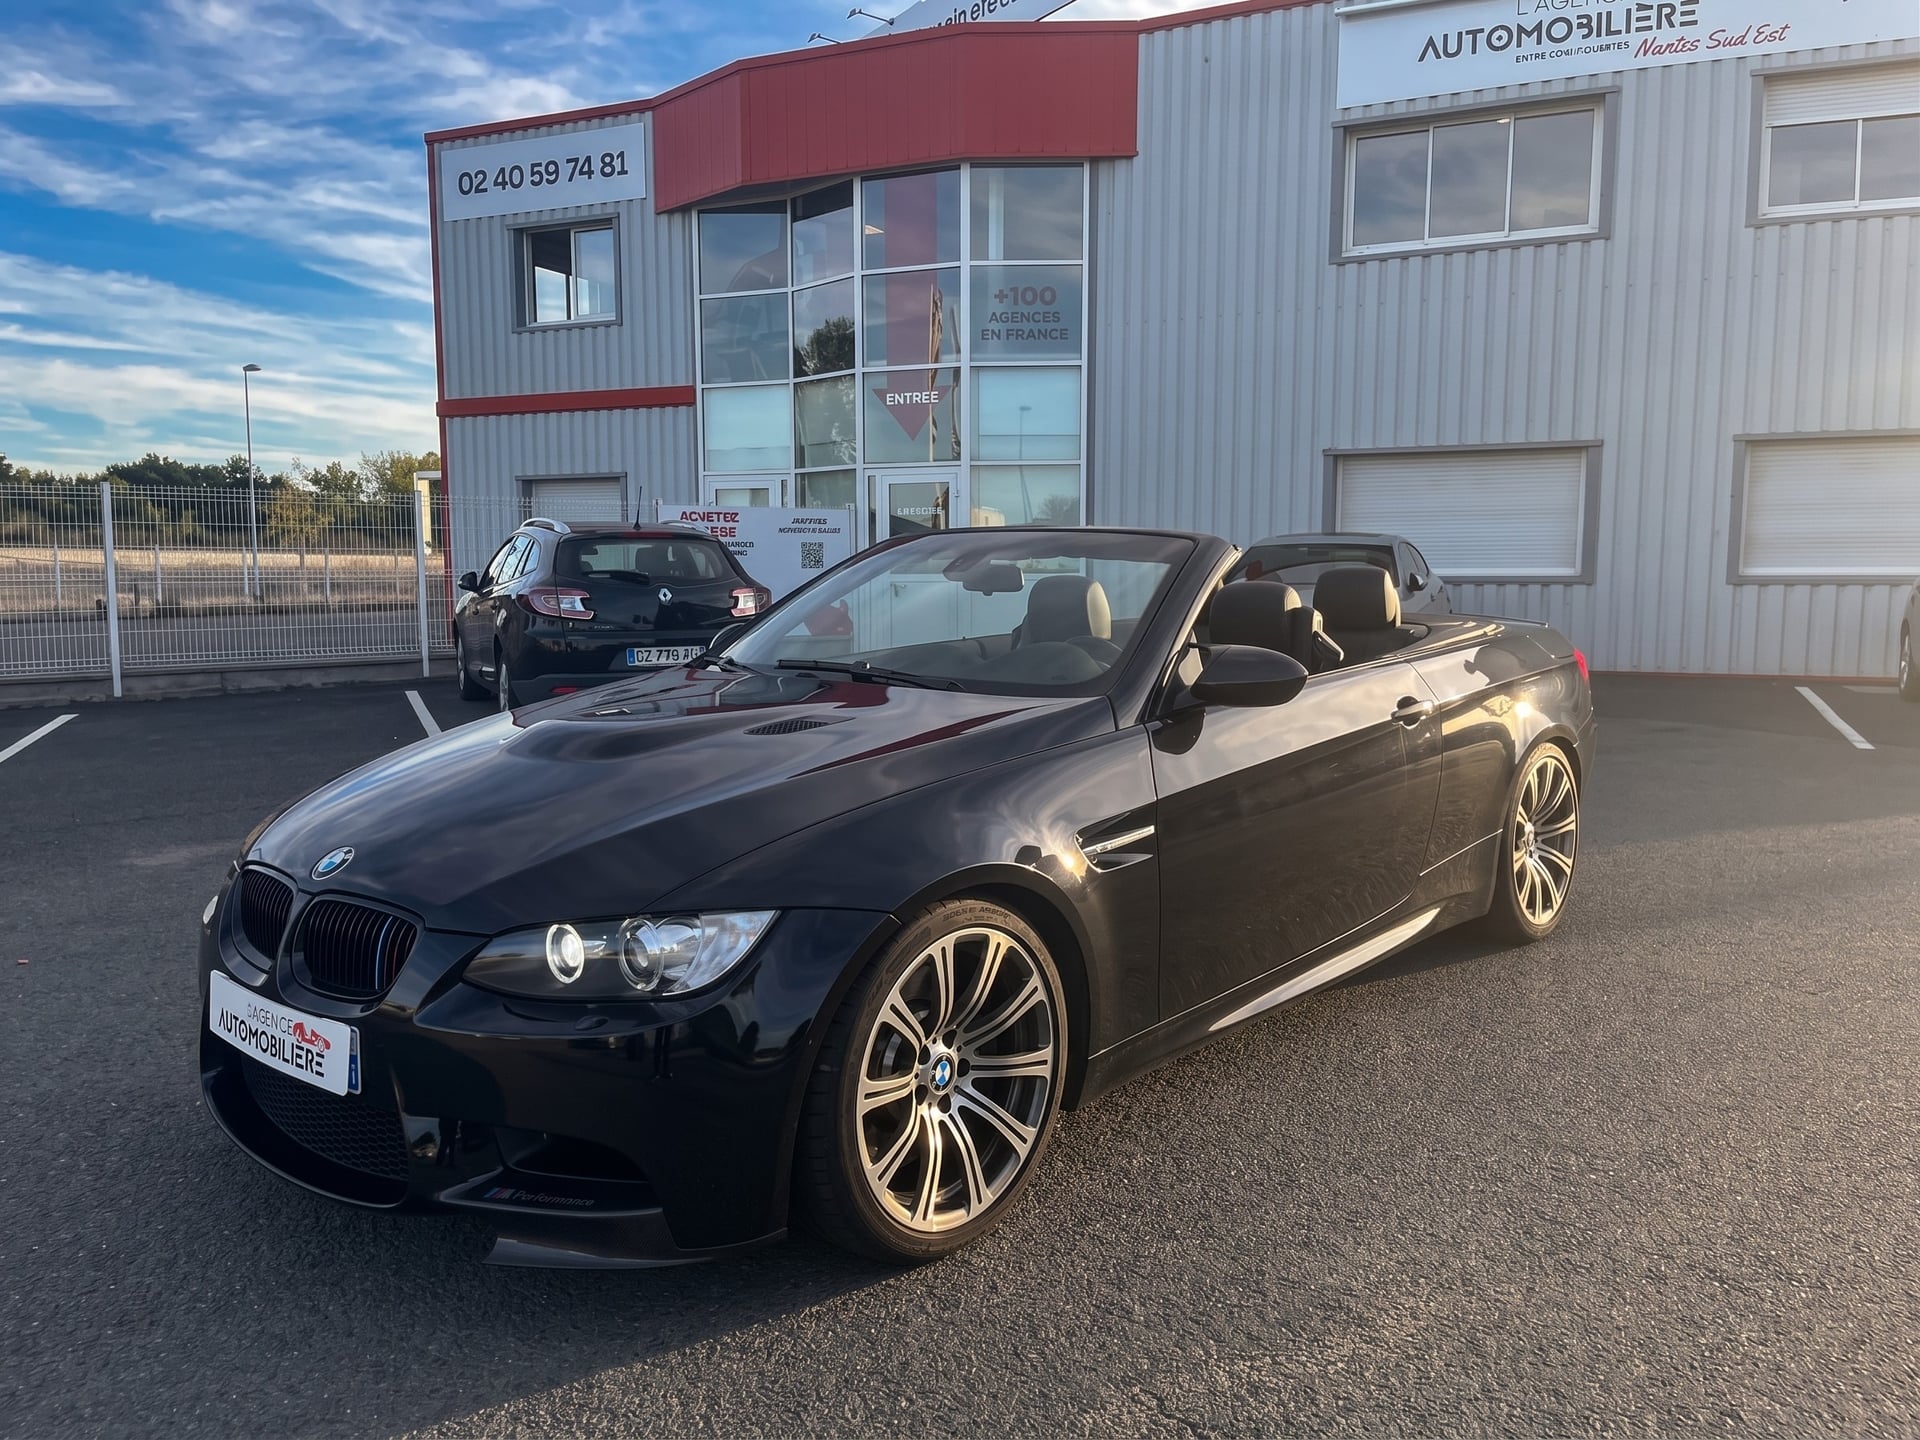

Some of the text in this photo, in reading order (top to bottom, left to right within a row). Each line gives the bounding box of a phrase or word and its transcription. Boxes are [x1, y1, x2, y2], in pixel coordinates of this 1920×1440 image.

[1634, 24, 1791, 58] Nantes Sud Est
[1515, 52, 1547, 63] ENTRE
[458, 151, 628, 195] 02 40 59 74 81
[994, 286, 1057, 306] +100
[988, 311, 1061, 324] AGENCES
[981, 328, 1069, 340] EN FRANCE
[886, 391, 939, 405] ENTREE
